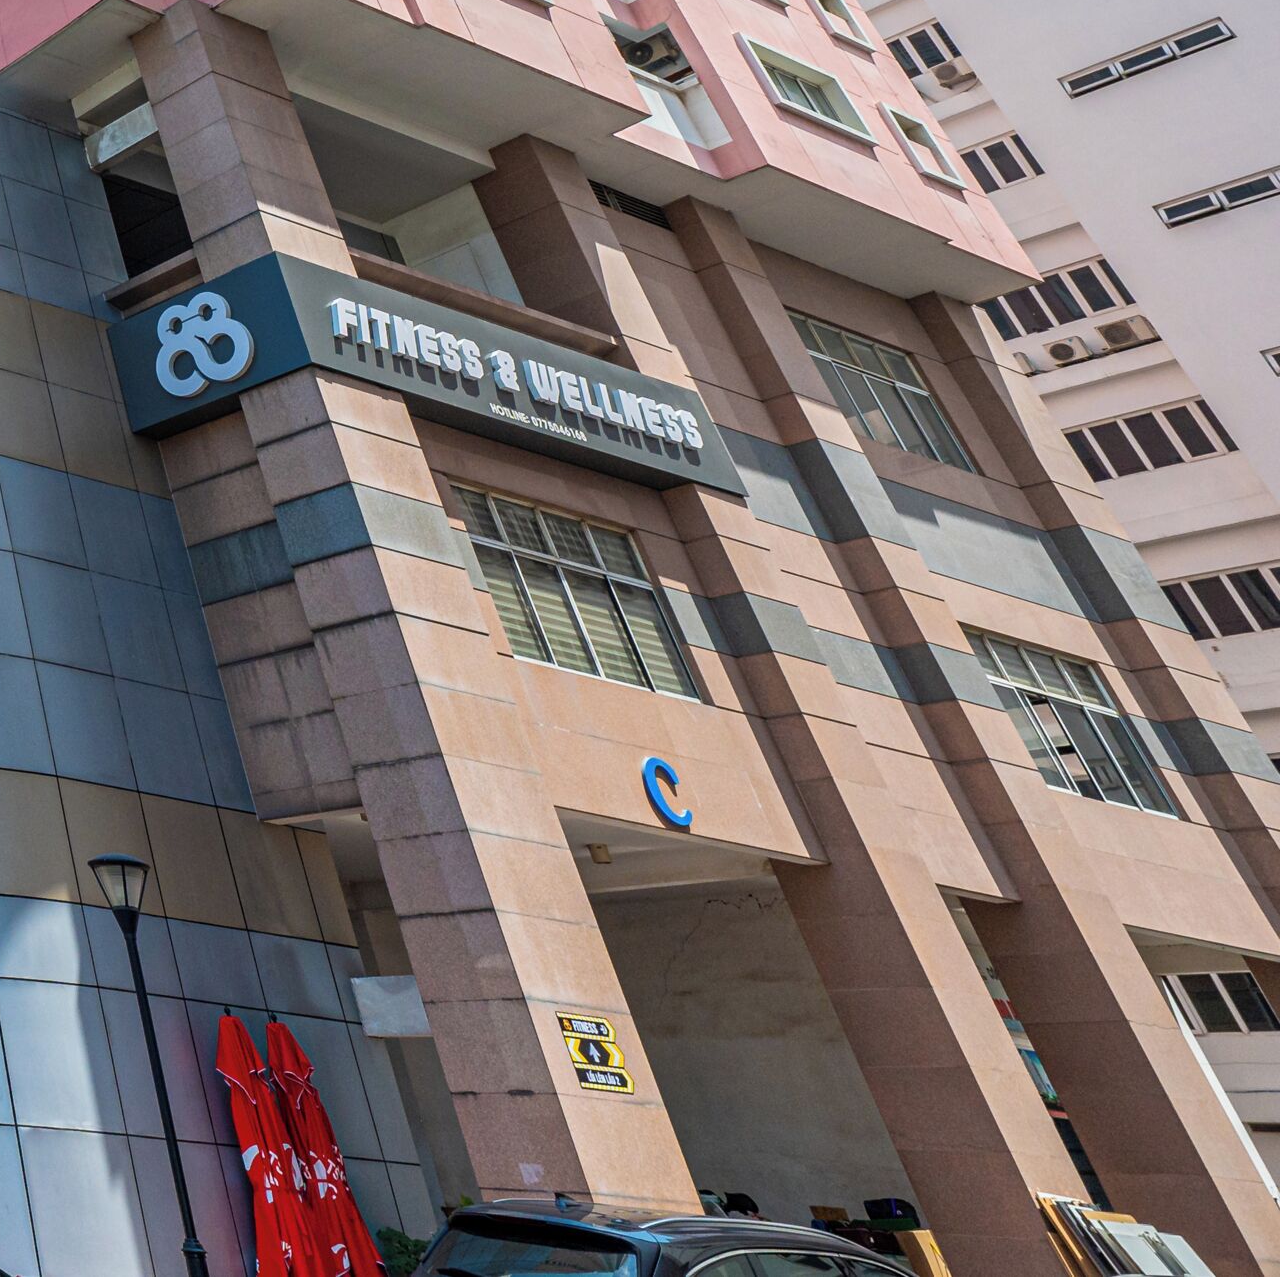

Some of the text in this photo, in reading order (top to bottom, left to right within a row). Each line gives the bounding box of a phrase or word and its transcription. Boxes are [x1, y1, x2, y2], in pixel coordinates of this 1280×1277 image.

[329, 297, 704, 450] FITNESS & WELLNESS
[489, 402, 530, 424] HOTLINE:
[642, 756, 693, 827] C
